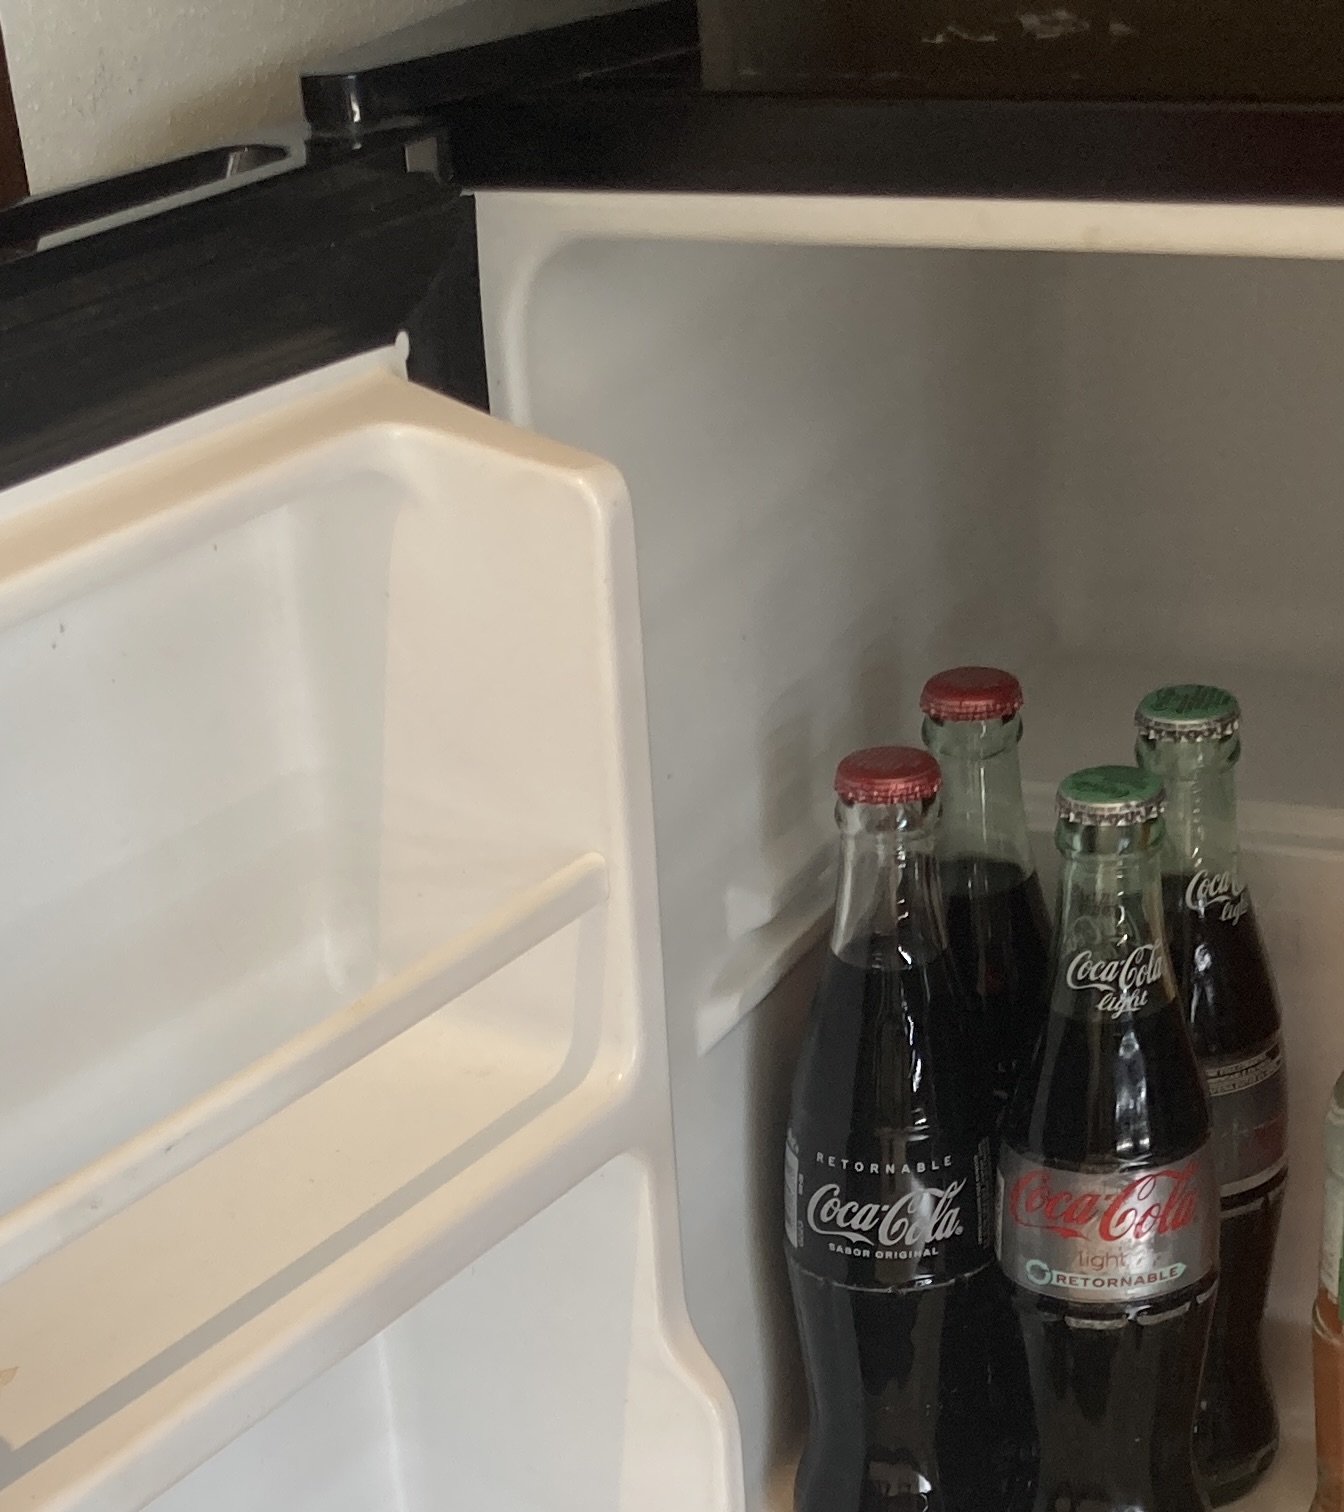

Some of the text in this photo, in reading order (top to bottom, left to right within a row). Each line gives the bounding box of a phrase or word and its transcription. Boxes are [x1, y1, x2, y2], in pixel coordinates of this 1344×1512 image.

[1066, 943, 1164, 994] Coca-Cola
[1096, 988, 1149, 1020] light
[816, 1151, 953, 1175] RETORNABLE
[807, 1177, 968, 1247] Coca-Cola
[1007, 1161, 1200, 1243] Coca-Cola
[828, 1242, 940, 1260] SABOR ORIGINAL
[1078, 1249, 1128, 1272] light
[1056, 1265, 1180, 1289] RETORNABLE
